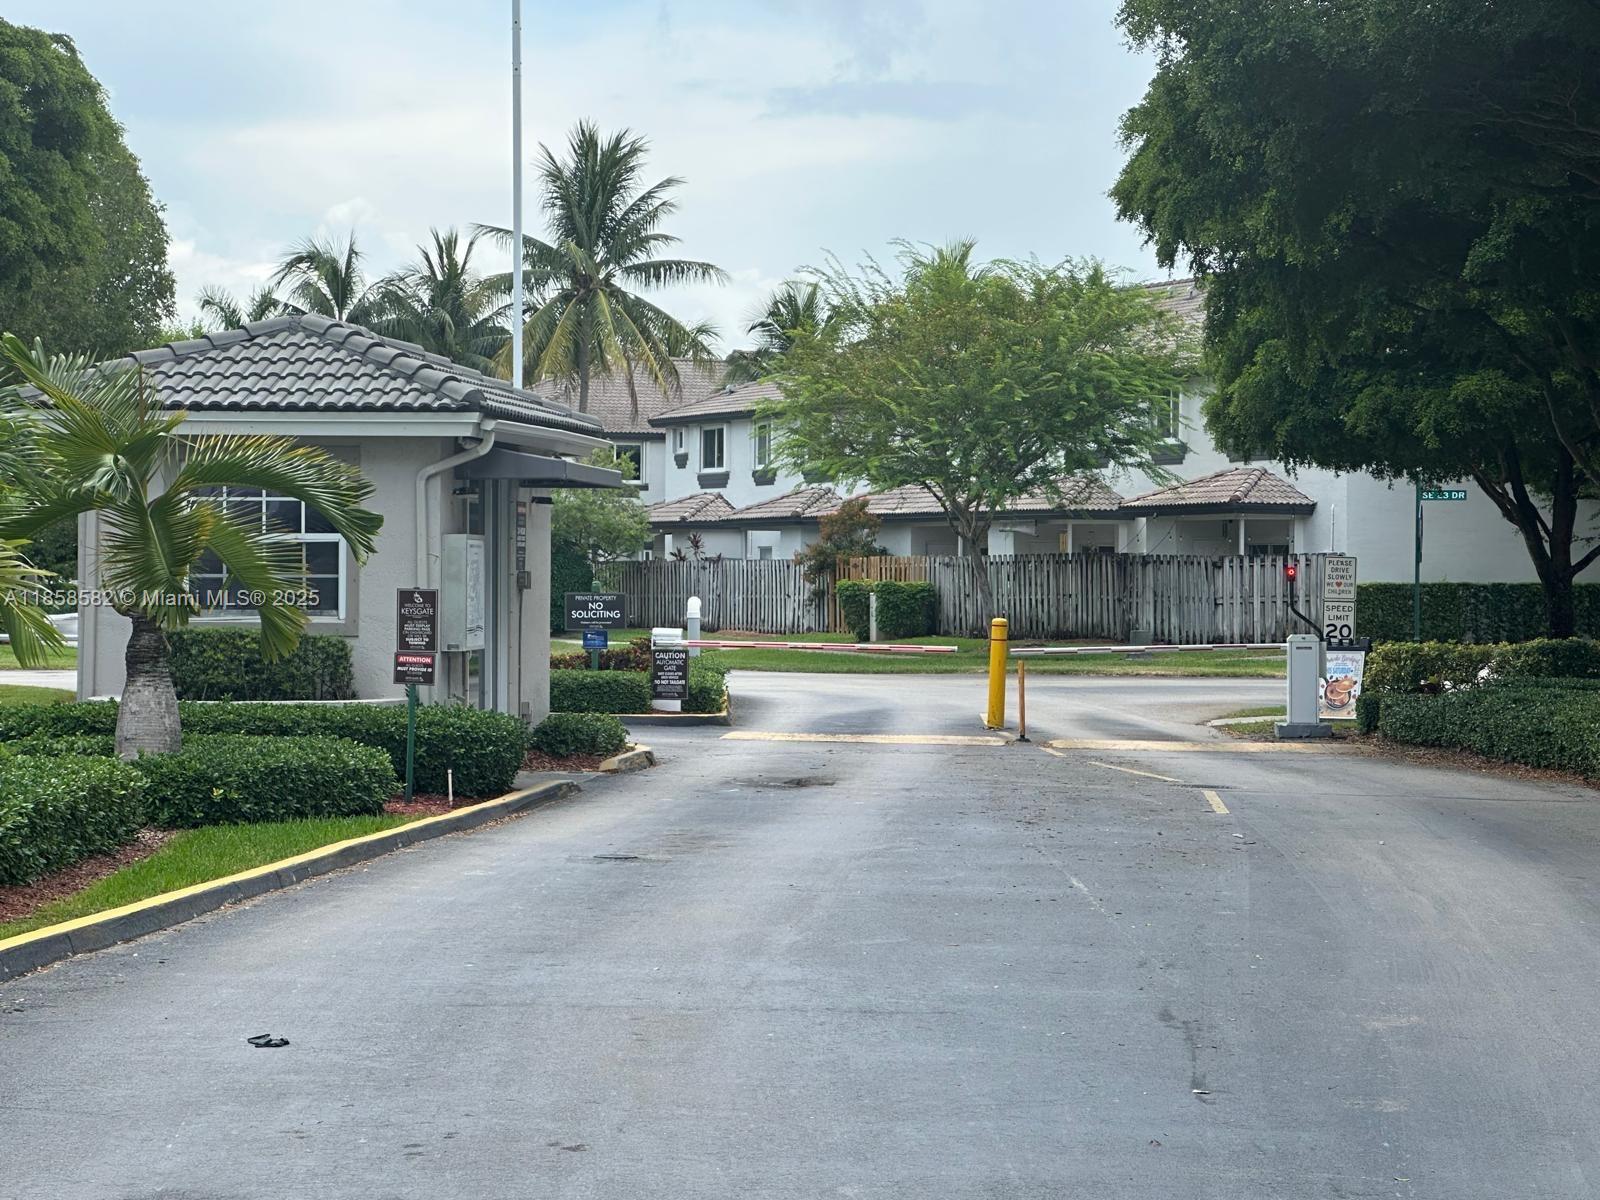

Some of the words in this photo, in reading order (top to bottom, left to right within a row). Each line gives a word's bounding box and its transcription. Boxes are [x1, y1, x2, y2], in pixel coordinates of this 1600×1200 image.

[1422, 491, 1434, 499] SE
[1451, 491, 1465, 499] DR
[588, 602, 604, 610] NO
[1325, 604, 1354, 612] SPEED
[401, 607, 435, 615] KEYSGATE
[571, 610, 621, 618] SOLICITING
[1325, 623, 1352, 638] 20
[399, 656, 431, 664] ATTENTION
